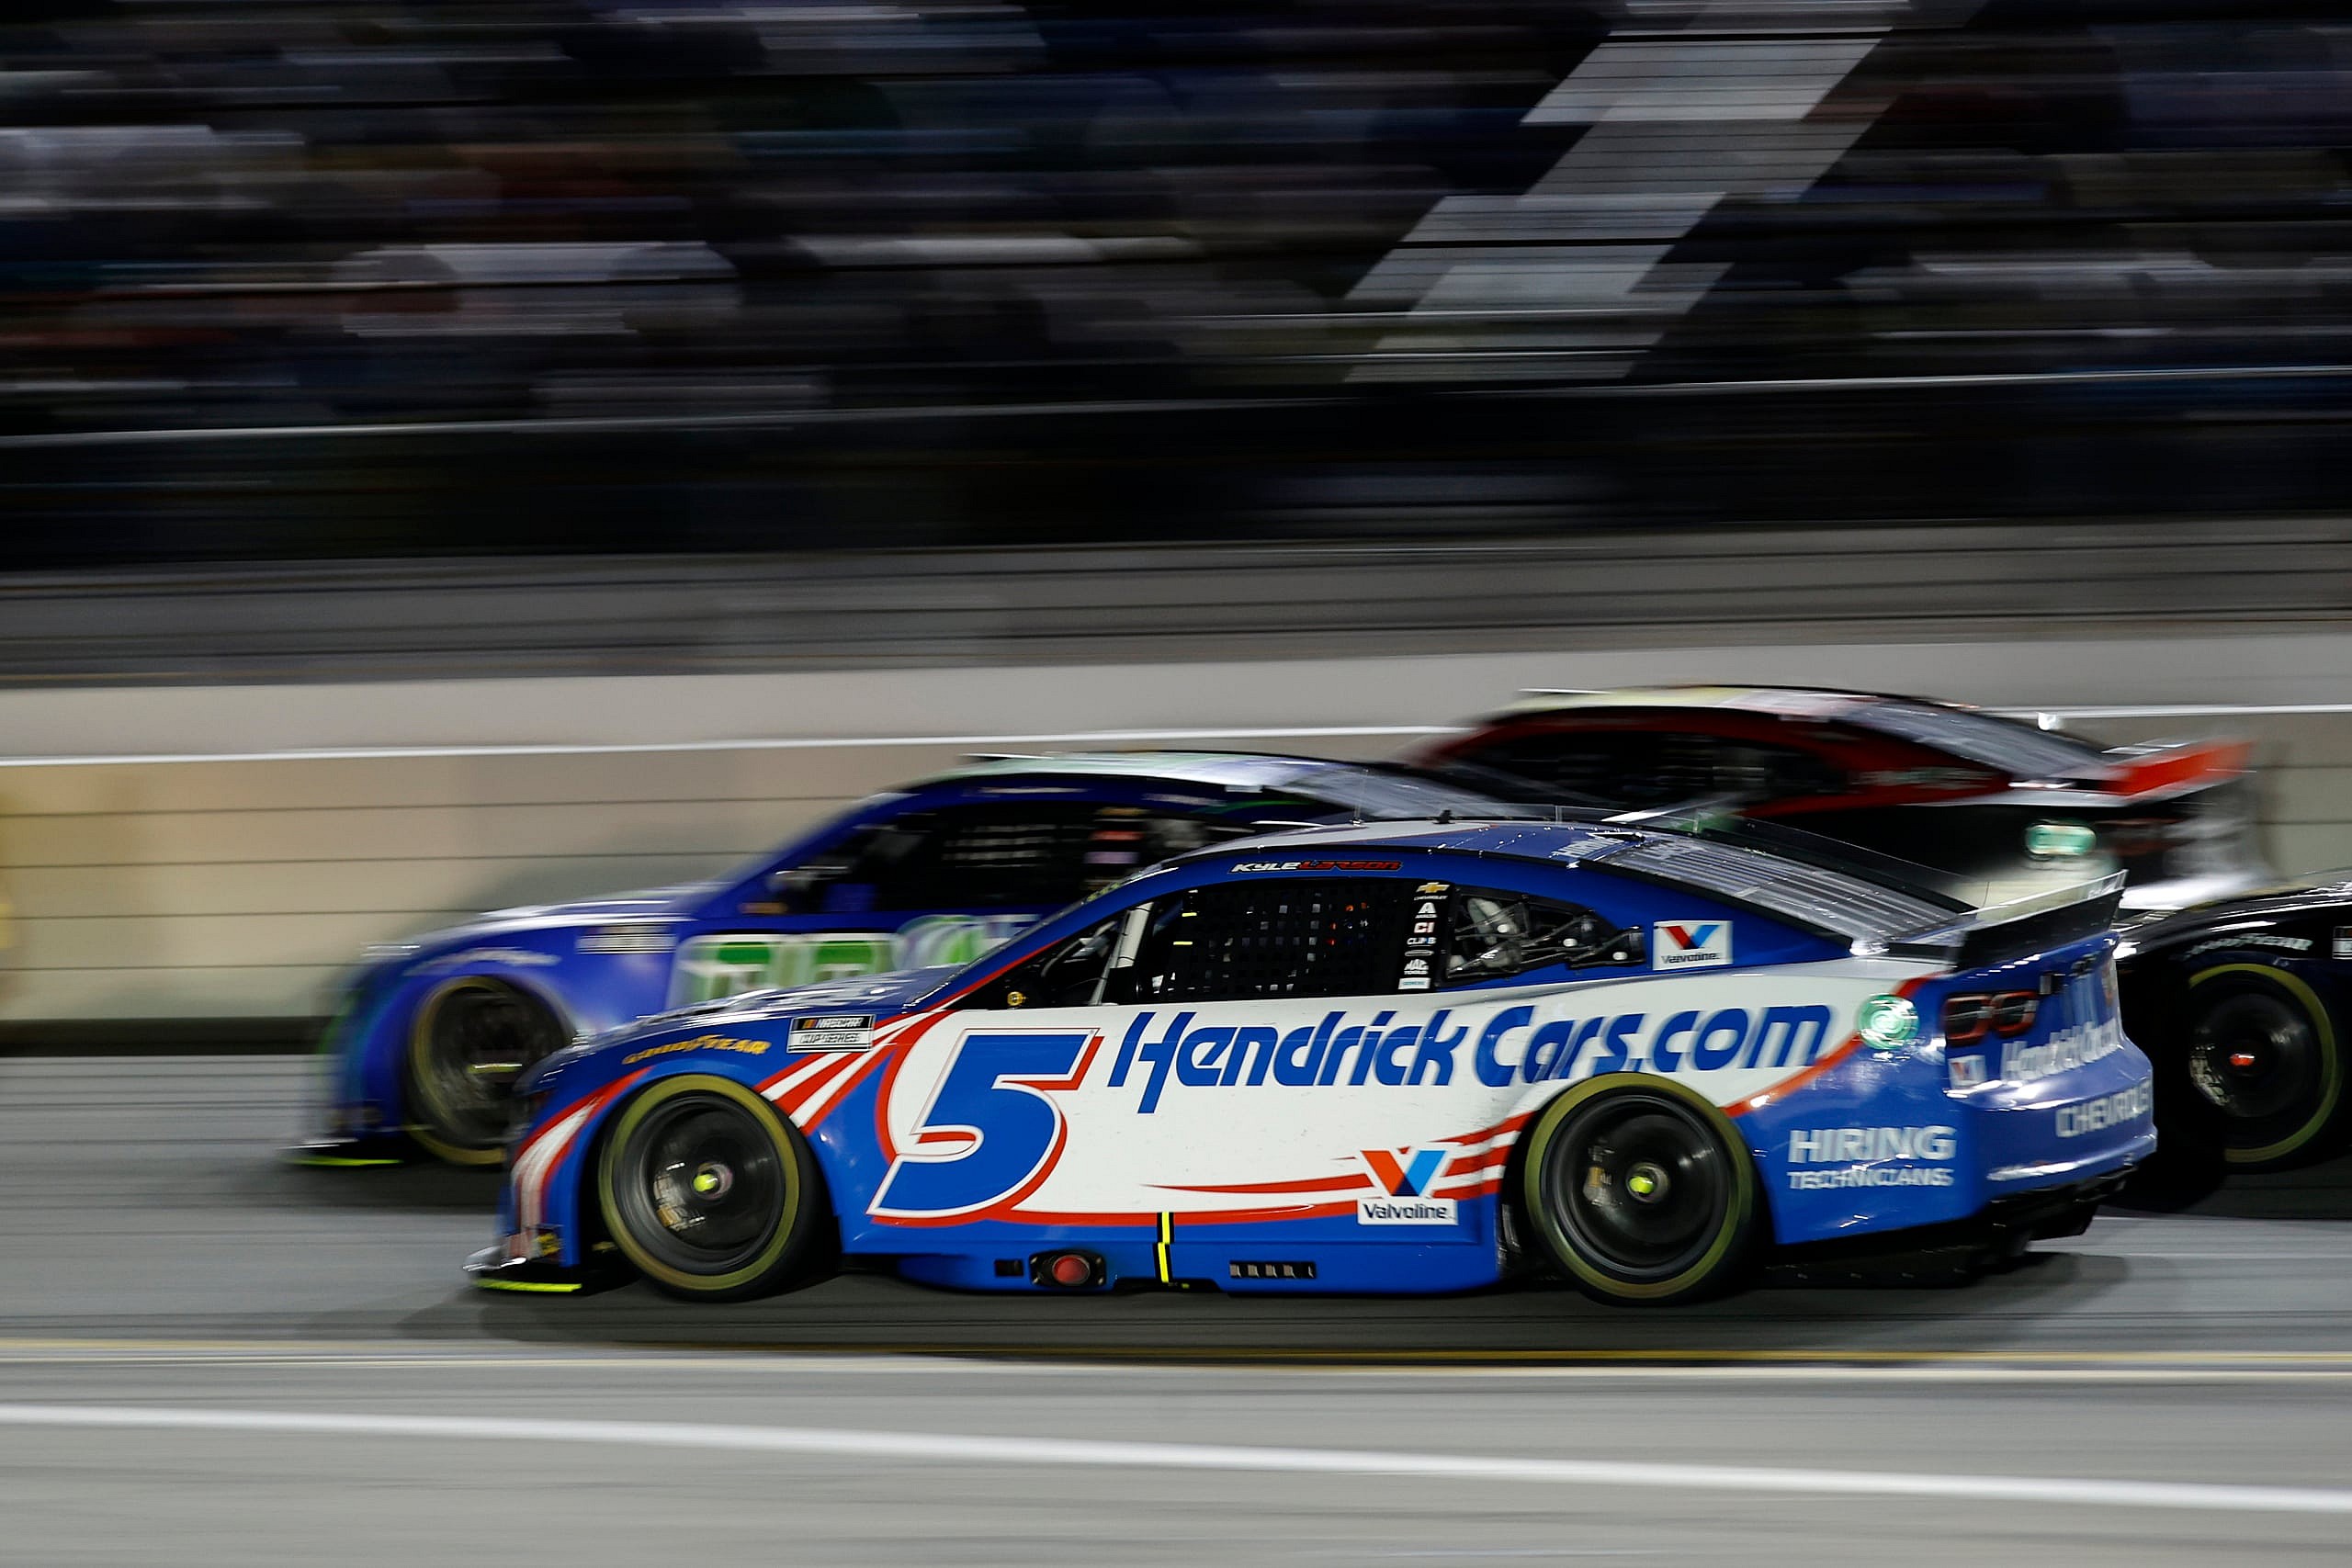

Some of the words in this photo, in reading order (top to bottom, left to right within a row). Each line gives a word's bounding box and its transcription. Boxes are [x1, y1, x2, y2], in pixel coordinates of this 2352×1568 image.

[816, 1017, 865, 1029] NASCAR
[621, 1034, 772, 1065] GOODYEAR
[866, 1027, 1102, 1222] 5
[1788, 1125, 1957, 1163] HIRING
[1363, 1202, 1449, 1220] Valvoline
